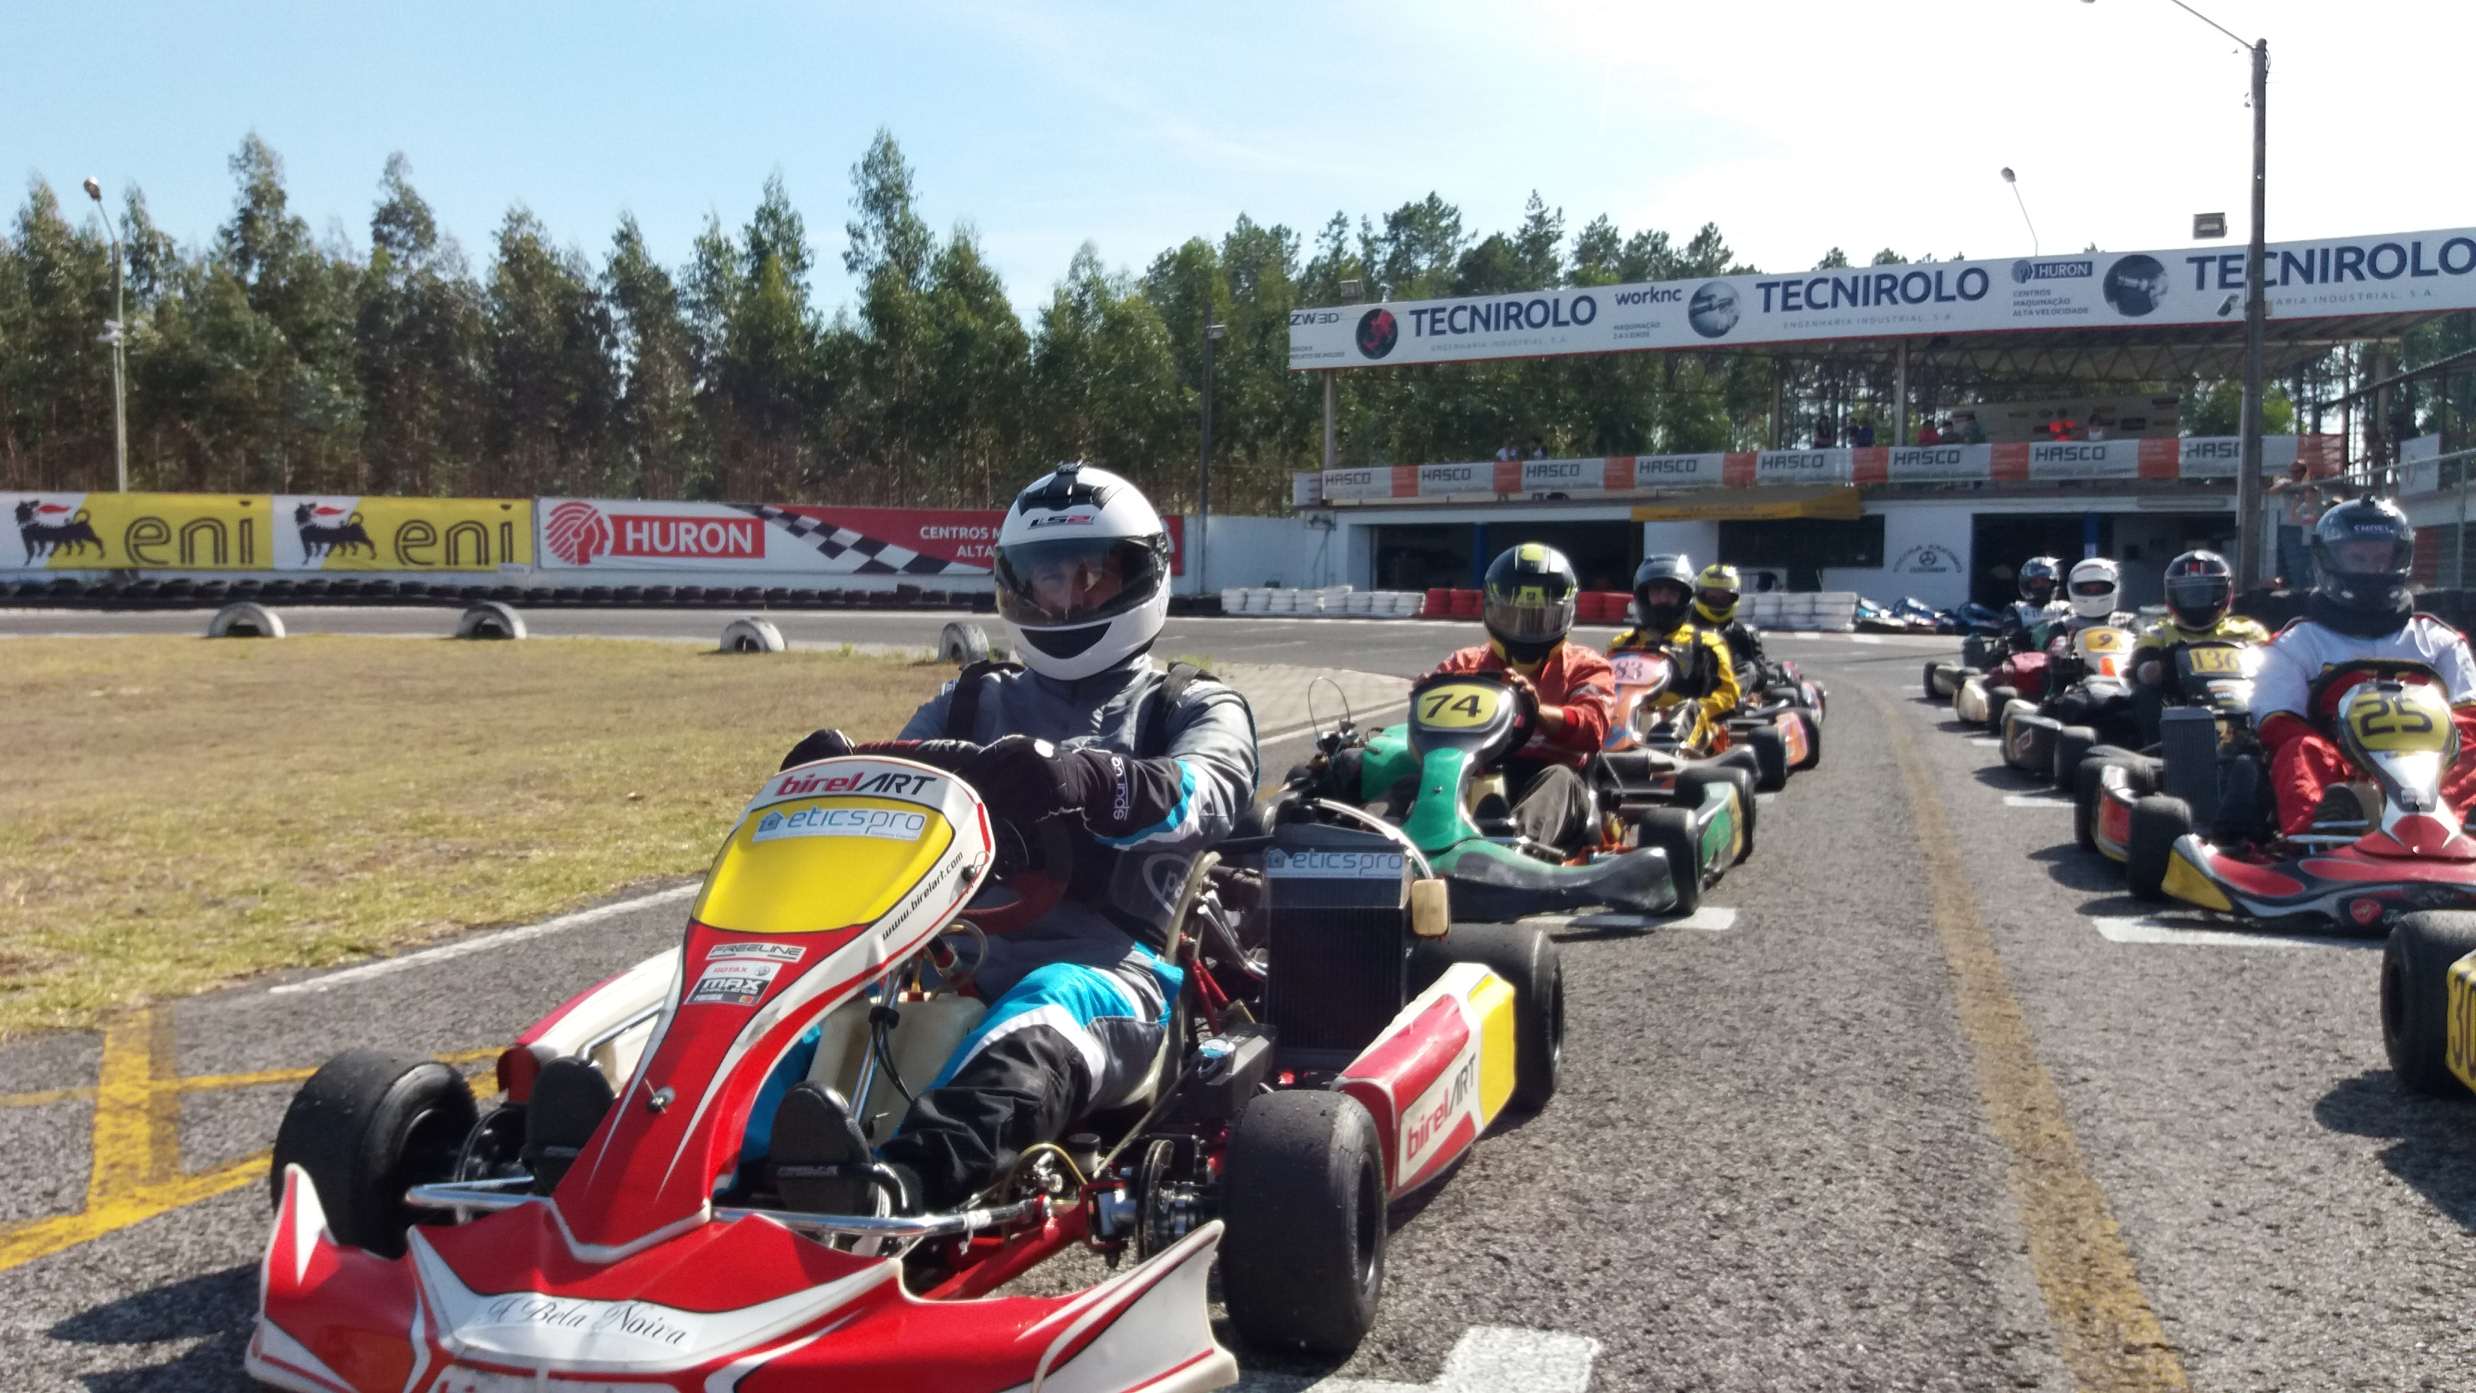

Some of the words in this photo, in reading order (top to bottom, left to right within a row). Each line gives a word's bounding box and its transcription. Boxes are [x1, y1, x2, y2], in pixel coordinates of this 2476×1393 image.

[2039, 264, 2088, 277] HURON
[1615, 286, 1682, 305] worknc
[1755, 267, 1990, 313] TECNIROLO
[1409, 295, 1597, 337] TECNIROLO
[1639, 459, 1697, 474] HASCO
[1761, 454, 1824, 470] HASCO
[1894, 450, 1960, 465] HASCO
[2035, 446, 2106, 461] HASCO
[1325, 472, 1371, 485] HASCO
[1421, 468, 1471, 481] HASCO
[1526, 463, 1580, 478] HASCO
[124, 501, 254, 566] eni
[393, 503, 513, 566] eni
[625, 520, 753, 555] HURON
[920, 526, 989, 540] CENTROS
[956, 544, 995, 557] ALTA
[1424, 692, 1482, 719] 74
[2355, 698, 2433, 737] 25
[775, 771, 937, 797] birelART
[787, 806, 926, 834] eticspro
[1297, 848, 1401, 875] eticspro
[880, 851, 964, 941] www.birelart.com
[710, 943, 803, 956] FREELINE
[1406, 1052, 1477, 1160] birelART
[521, 1299, 590, 1328] Bela
[592, 1302, 687, 1345] Noiva
